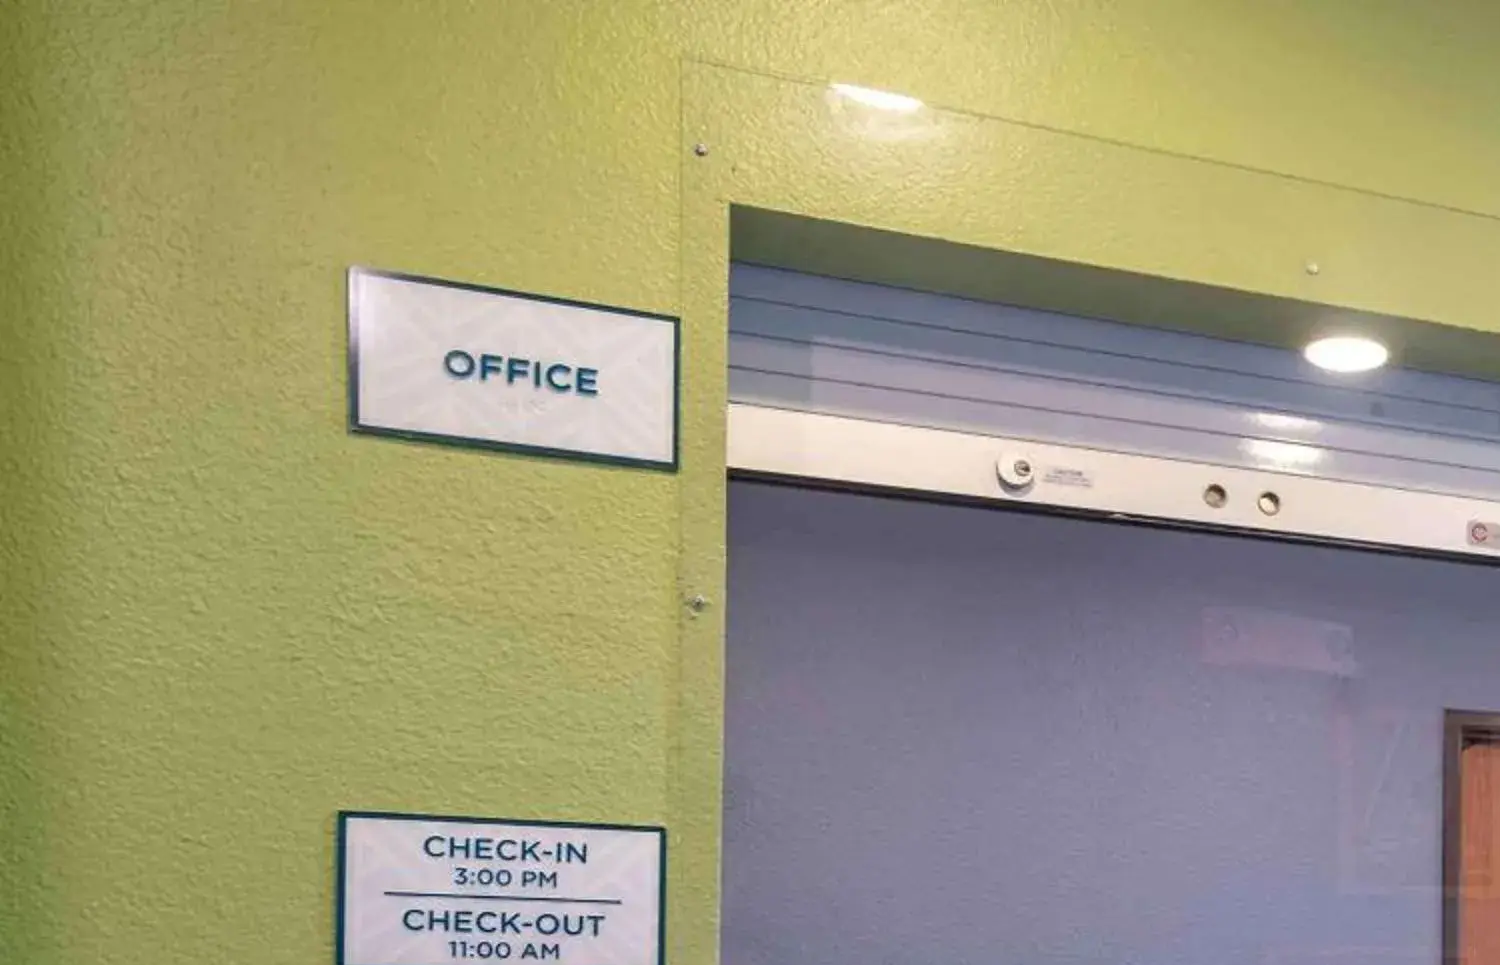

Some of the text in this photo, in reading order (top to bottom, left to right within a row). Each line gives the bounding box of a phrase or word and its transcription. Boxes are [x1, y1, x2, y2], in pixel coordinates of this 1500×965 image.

[443, 349, 599, 396] OFFICE
[423, 836, 588, 864] CHECK-IN
[454, 867, 558, 889] 3:00 PM
[402, 909, 605, 937] CHECK-OUT
[448, 941, 561, 961] 11:00 AM
